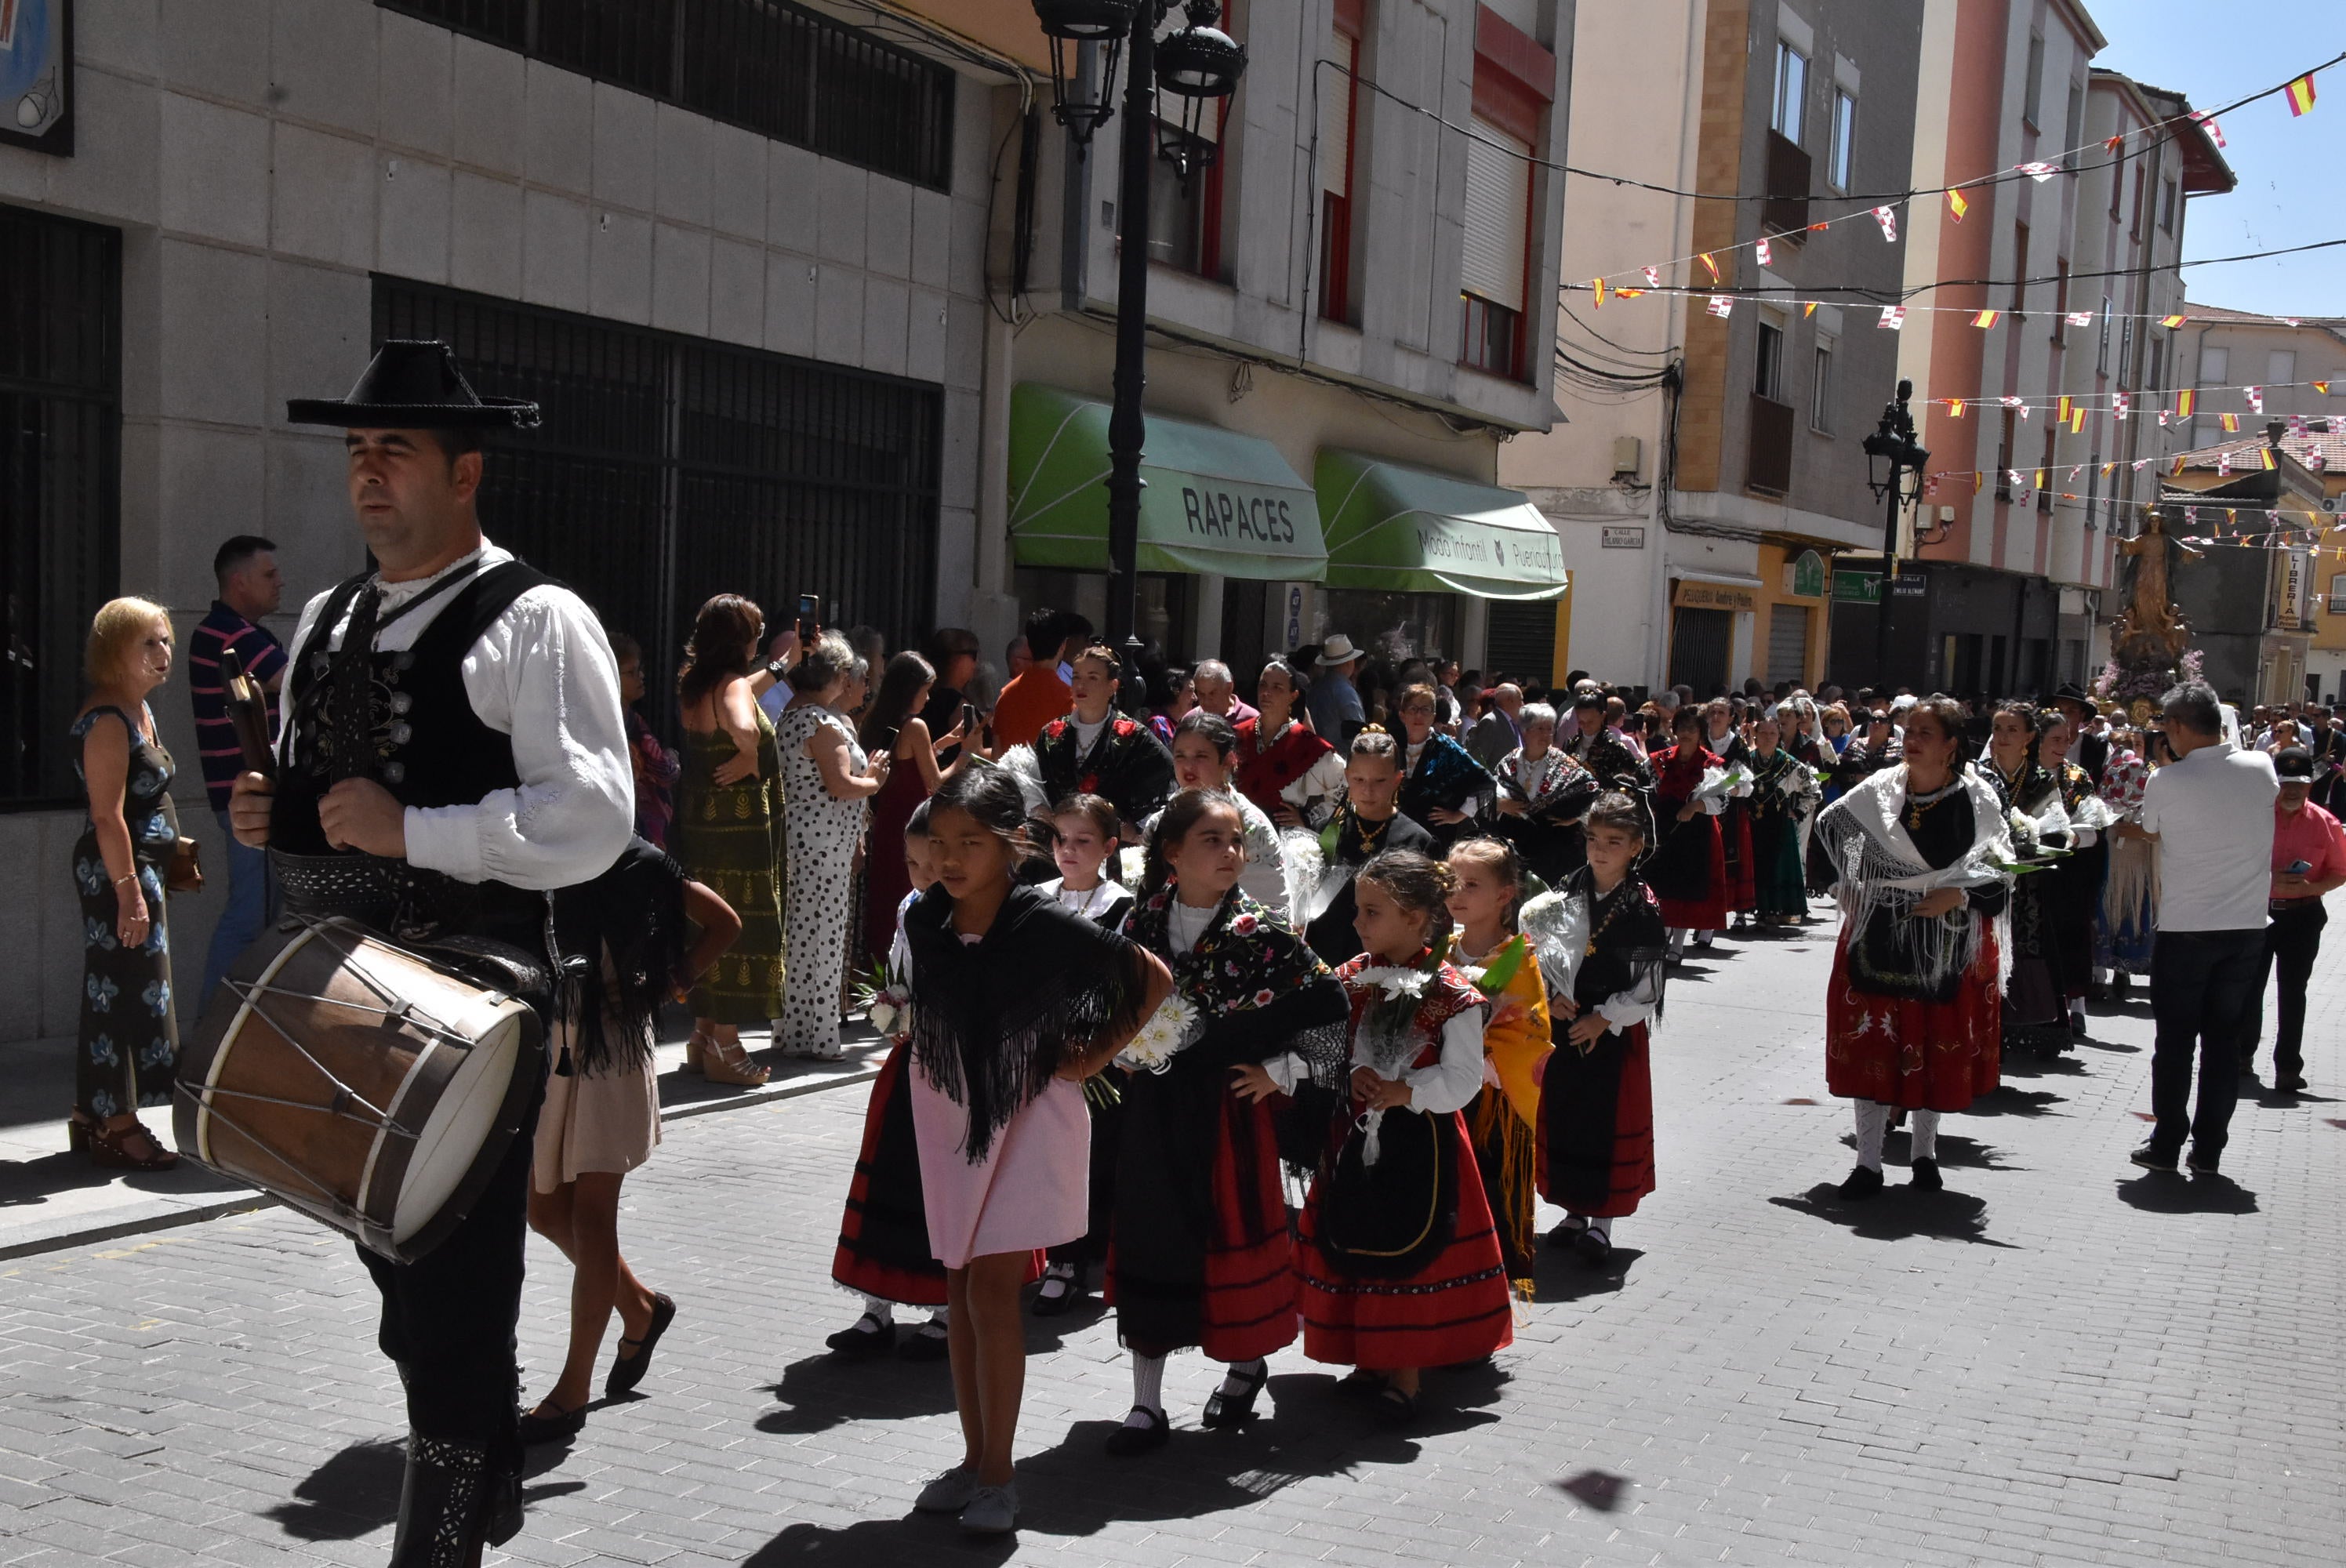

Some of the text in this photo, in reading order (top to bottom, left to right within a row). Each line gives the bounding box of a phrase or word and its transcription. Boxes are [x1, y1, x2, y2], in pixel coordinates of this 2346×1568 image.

[1182, 487, 1294, 543] RAPACES
[1418, 529, 1564, 570] Moda infantil Puericultura
